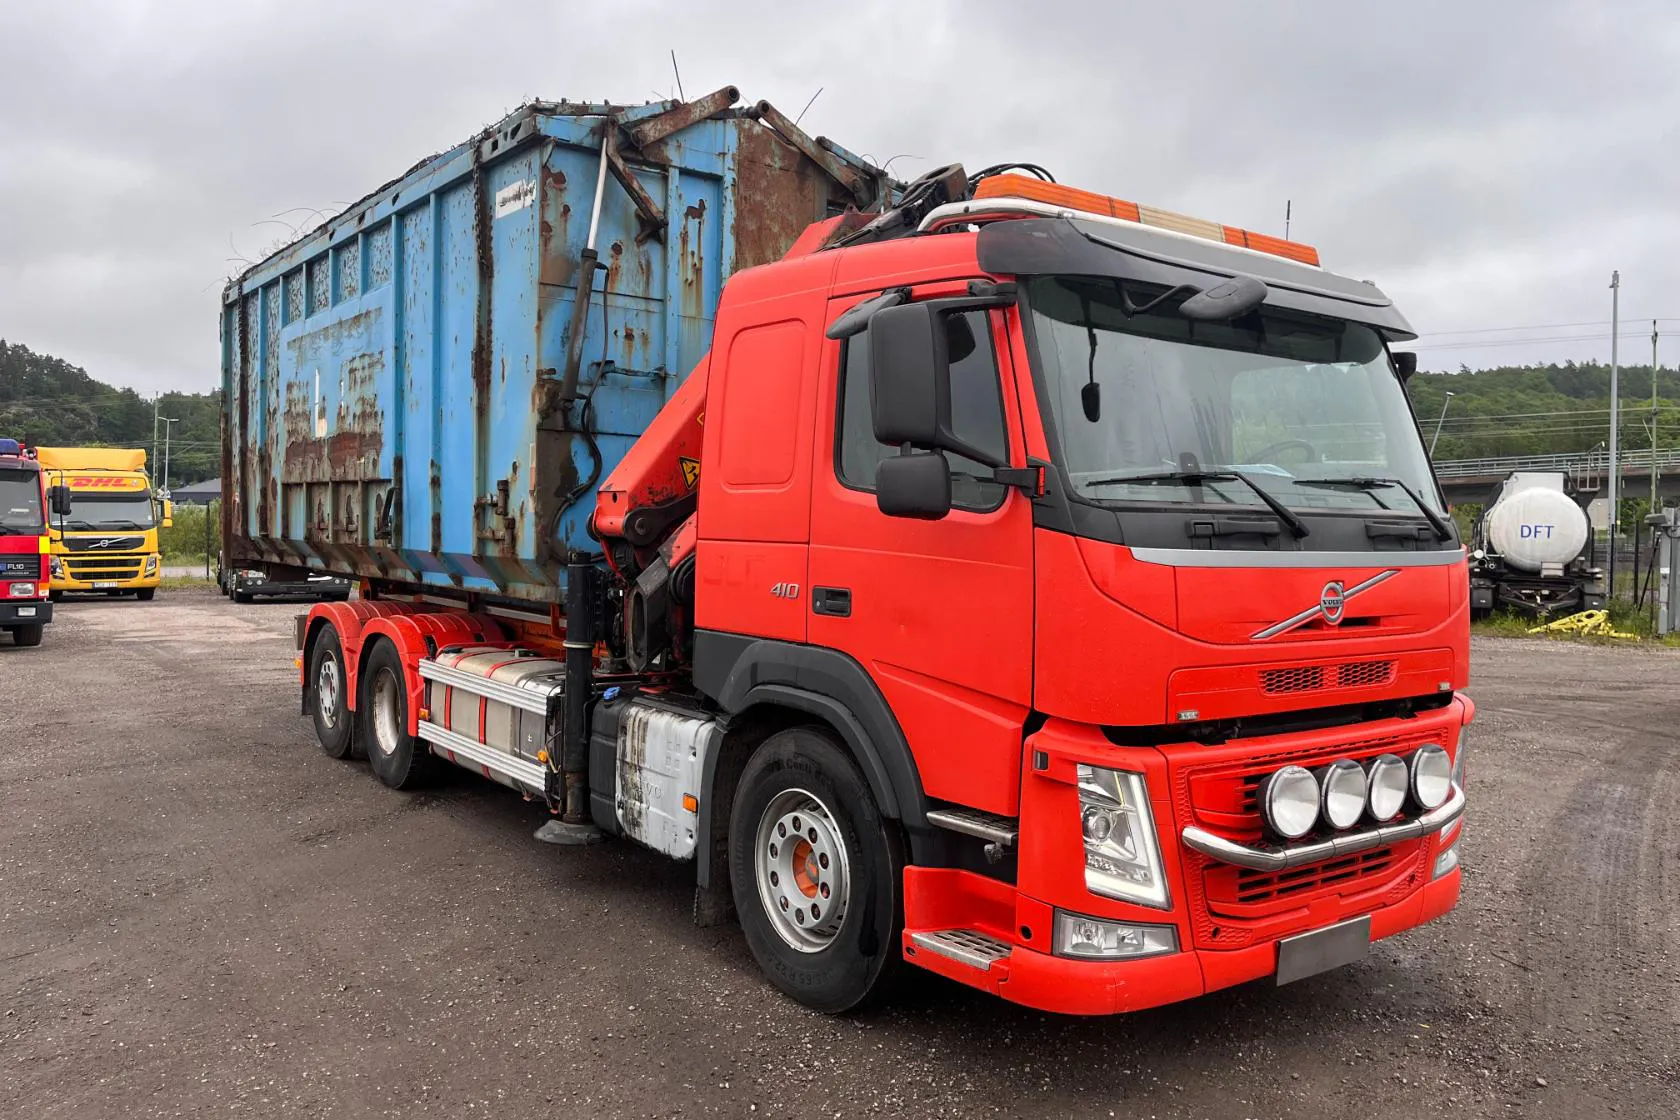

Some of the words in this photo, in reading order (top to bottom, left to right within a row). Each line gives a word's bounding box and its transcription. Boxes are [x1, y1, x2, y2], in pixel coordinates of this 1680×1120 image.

[72, 477, 128, 487] DHL
[1520, 525, 1555, 538] DFT
[771, 582, 799, 599] 410
